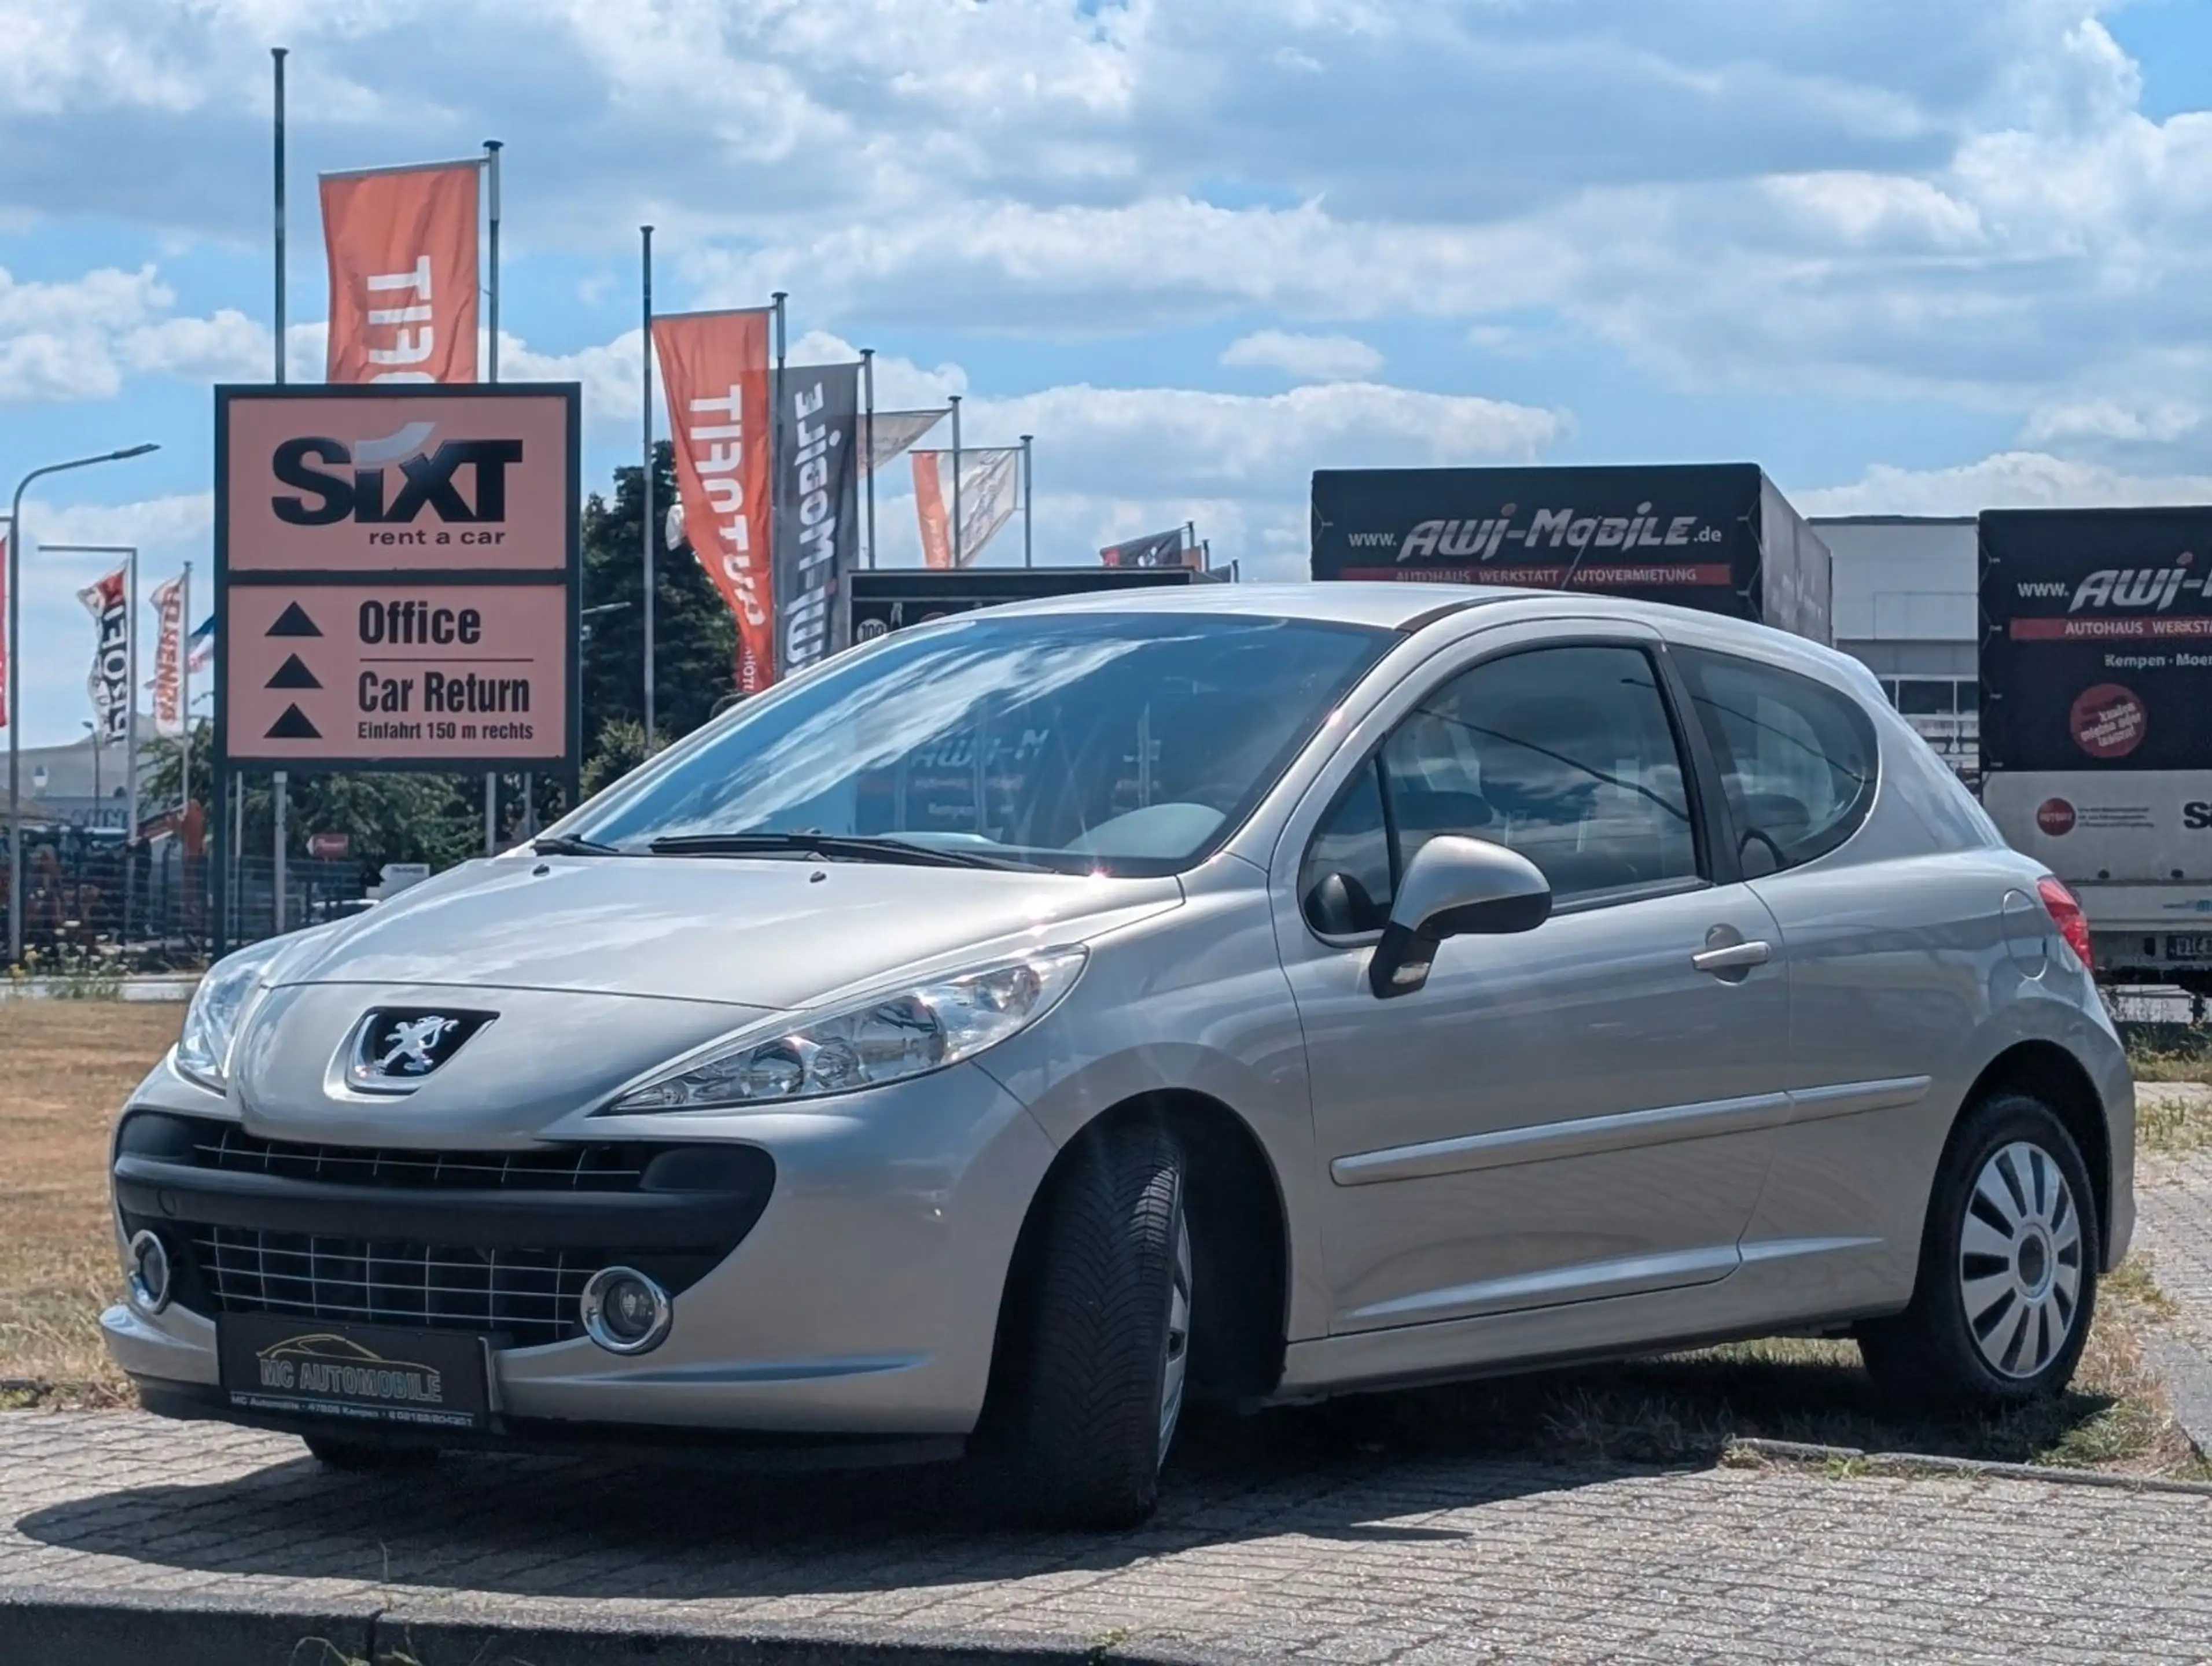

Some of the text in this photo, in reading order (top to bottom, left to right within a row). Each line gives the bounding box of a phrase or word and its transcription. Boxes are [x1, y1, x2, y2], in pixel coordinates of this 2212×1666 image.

[369, 530, 506, 545] rent a car
[1478, 569, 1559, 583] WERKSTATT
[1572, 567, 1698, 583] UTOVERMIETUNG
[359, 600, 481, 645] Office
[2064, 619, 2212, 635] AUTOHAUS WERKST
[2104, 654, 2166, 669] Kempen
[358, 670, 530, 713] Car Return
[357, 721, 534, 740] Einfahrt 150 m rechts
[260, 1359, 444, 1403] MC AUTOMOBILE
